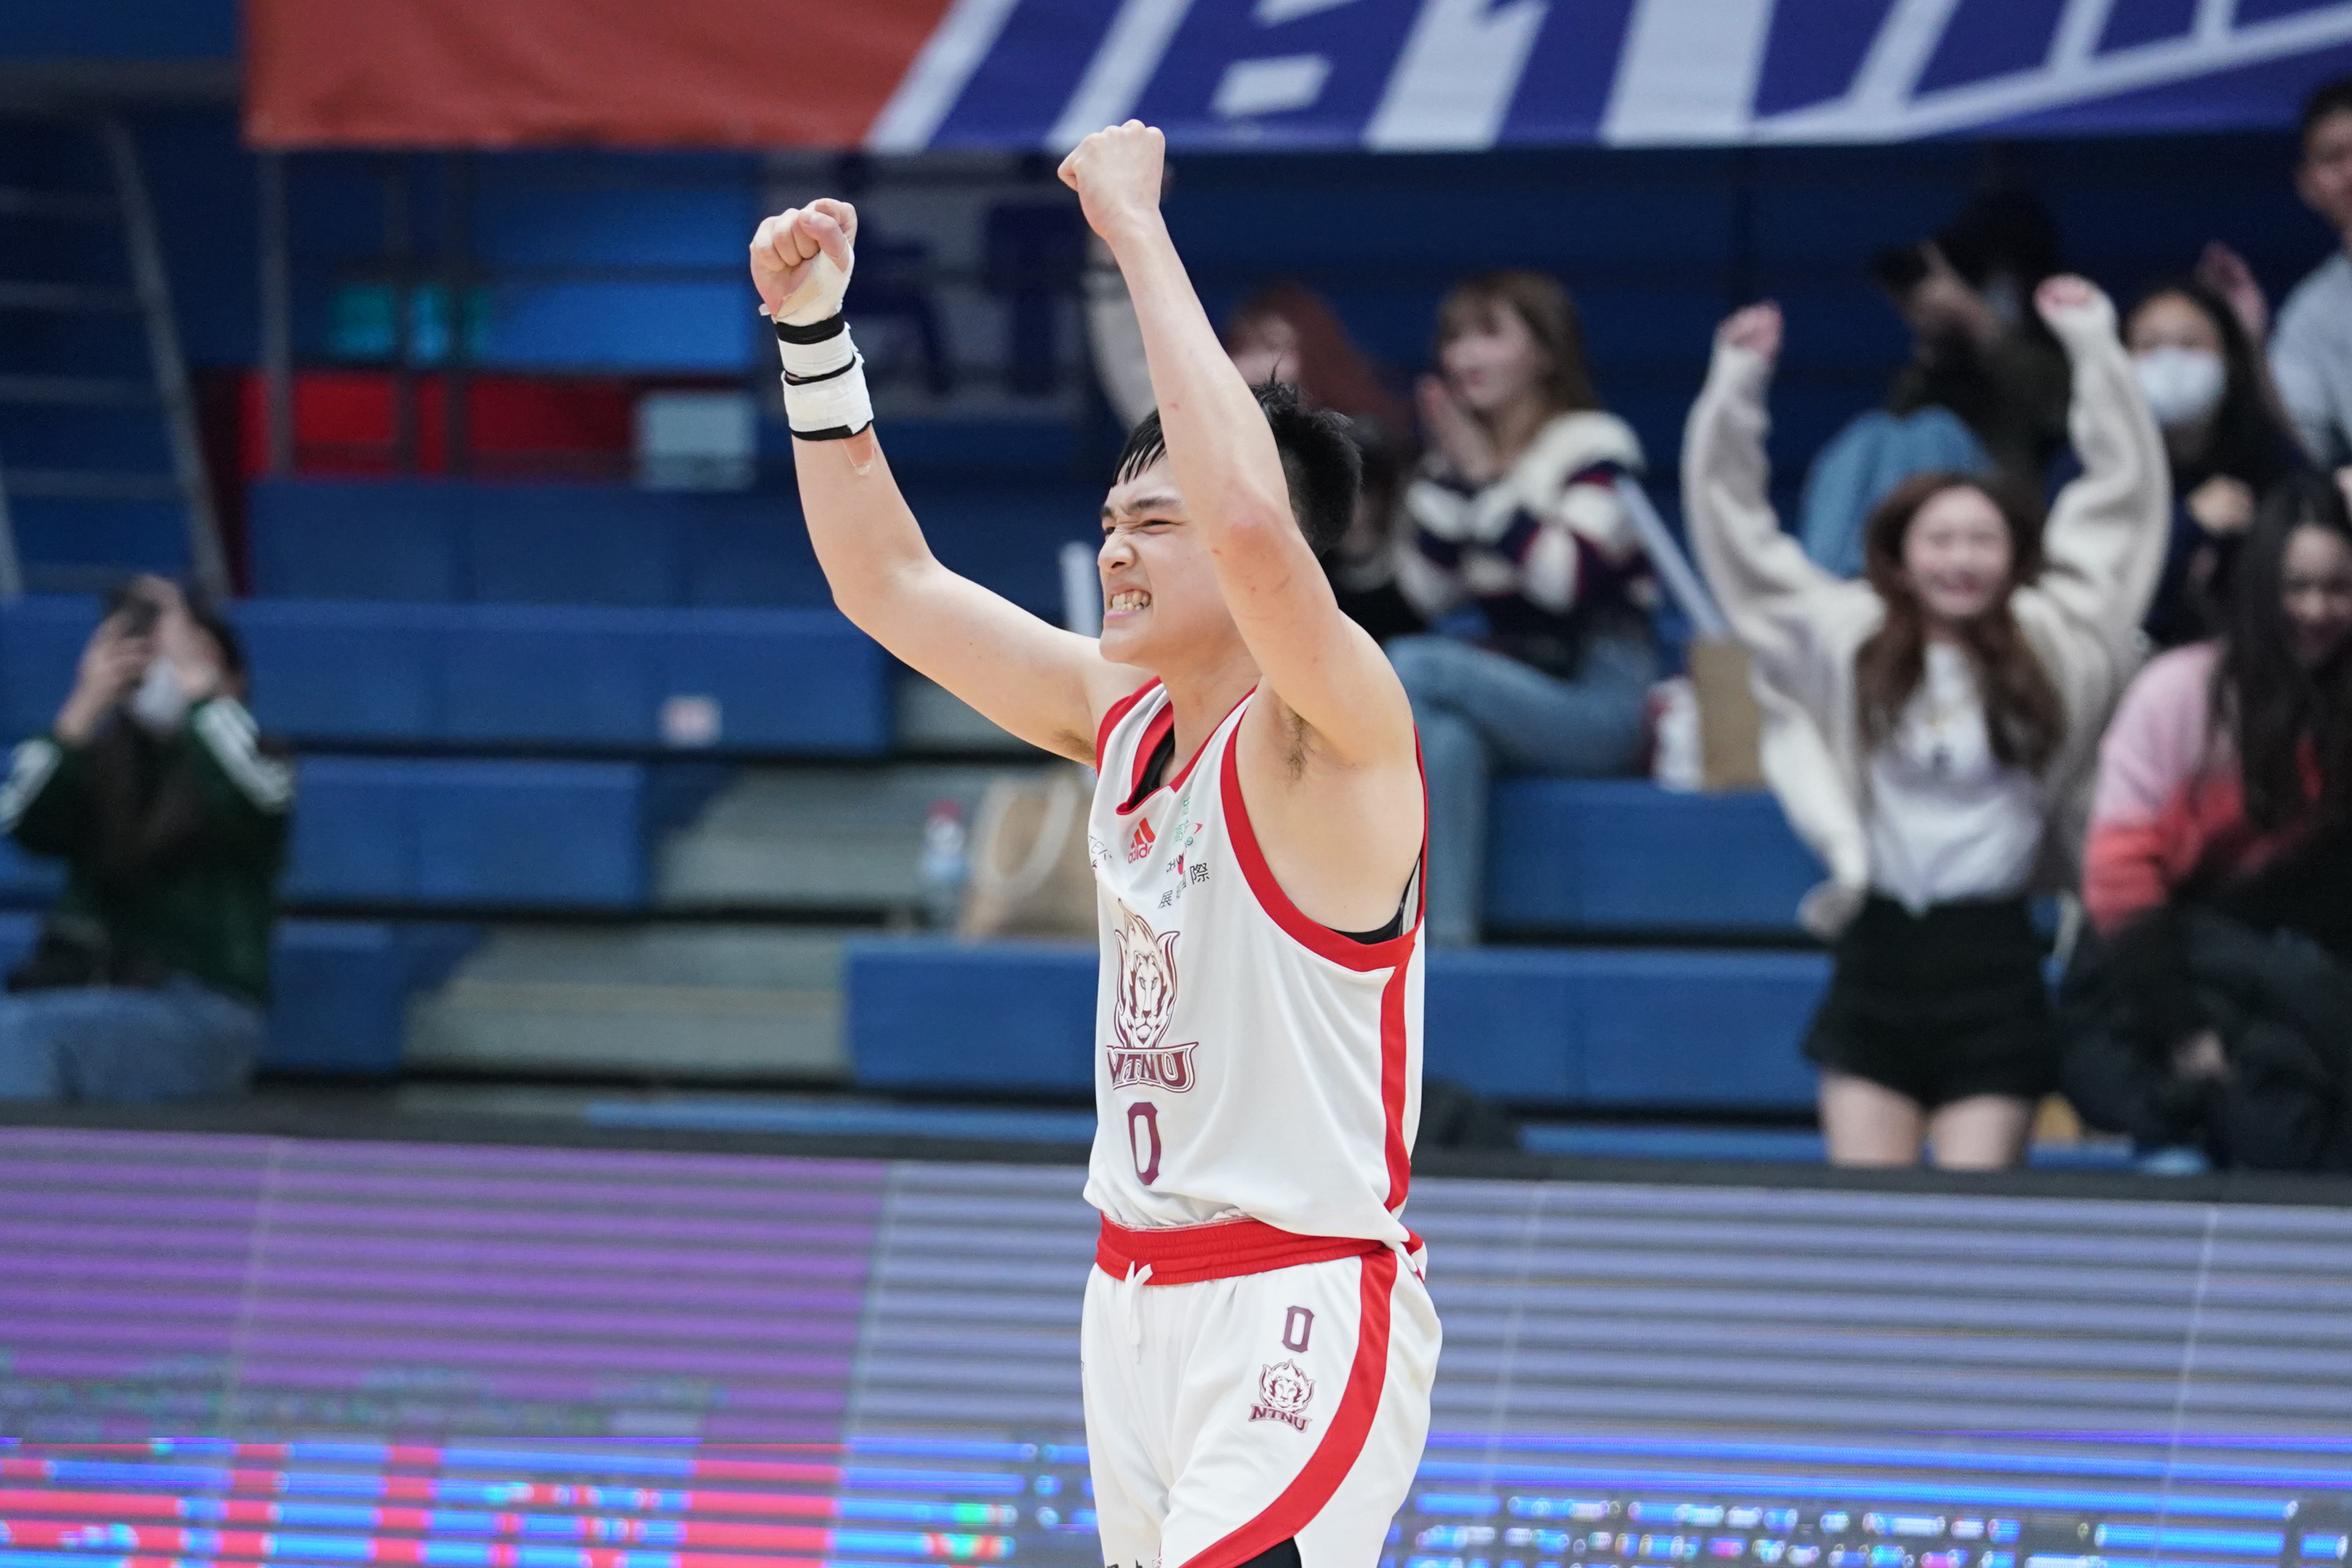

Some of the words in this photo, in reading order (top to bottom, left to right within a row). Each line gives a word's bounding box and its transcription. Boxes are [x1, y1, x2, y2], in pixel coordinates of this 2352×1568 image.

[1127, 1102, 1162, 1186] 0
[1281, 1305, 1315, 1353] 0
[1248, 1403, 1312, 1434] NTNU
